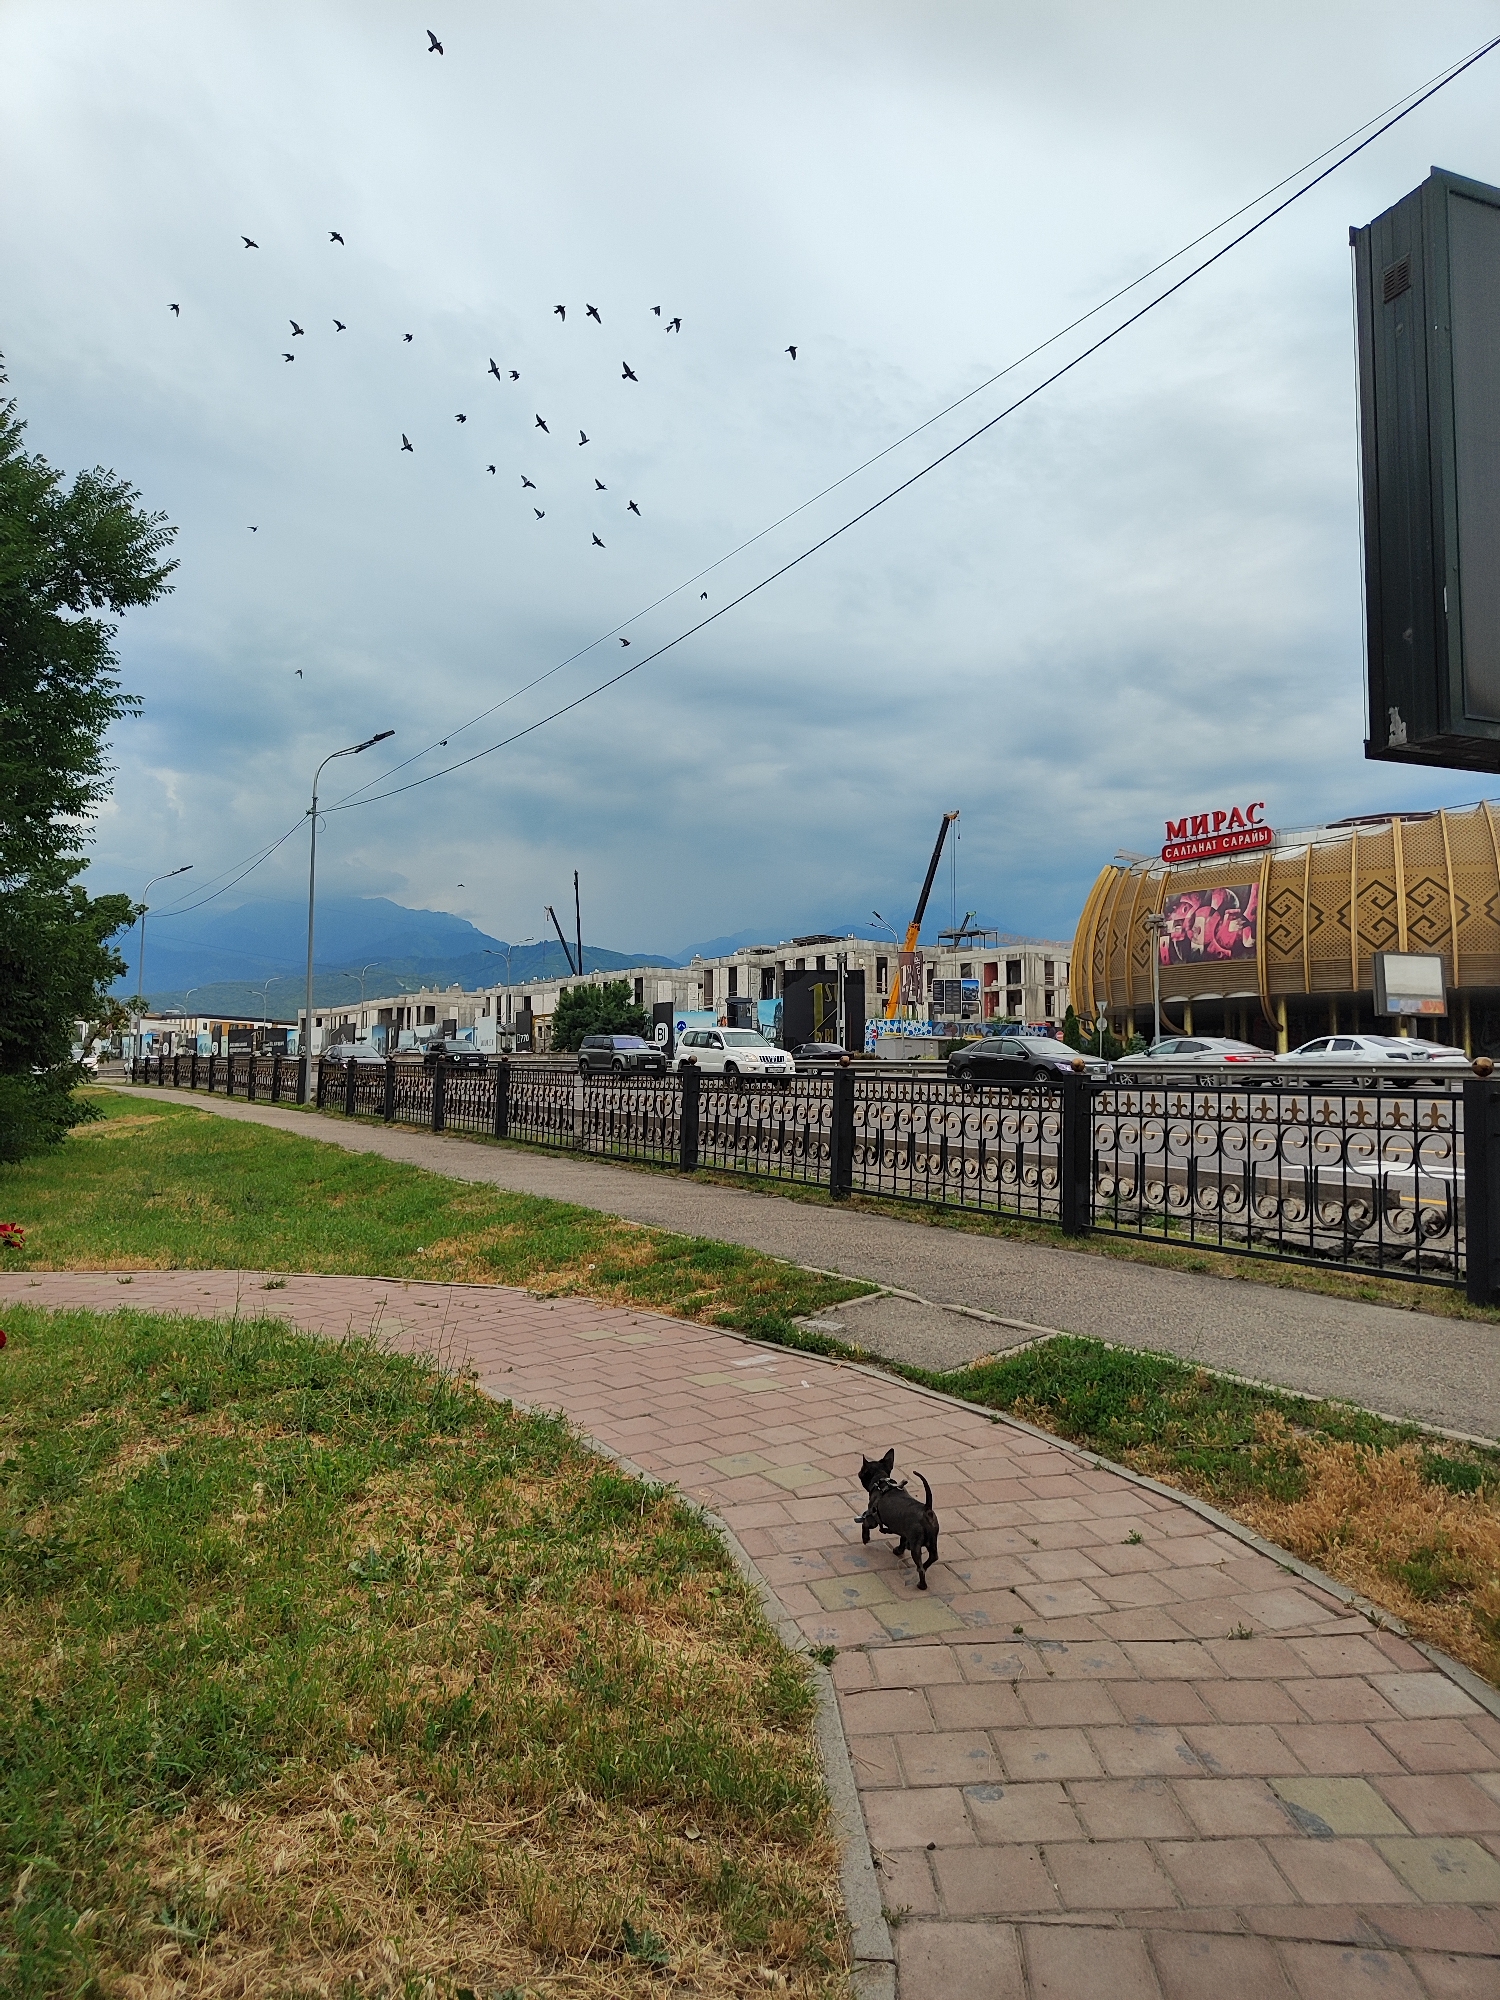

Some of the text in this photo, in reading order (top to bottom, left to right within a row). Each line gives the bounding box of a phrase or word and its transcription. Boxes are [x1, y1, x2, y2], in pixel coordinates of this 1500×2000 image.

[1165, 802, 1265, 841] МИРАС
[1165, 830, 1268, 858] САЛТАНАТ САРАЙЫ
[658, 1027, 666, 1041] BI
